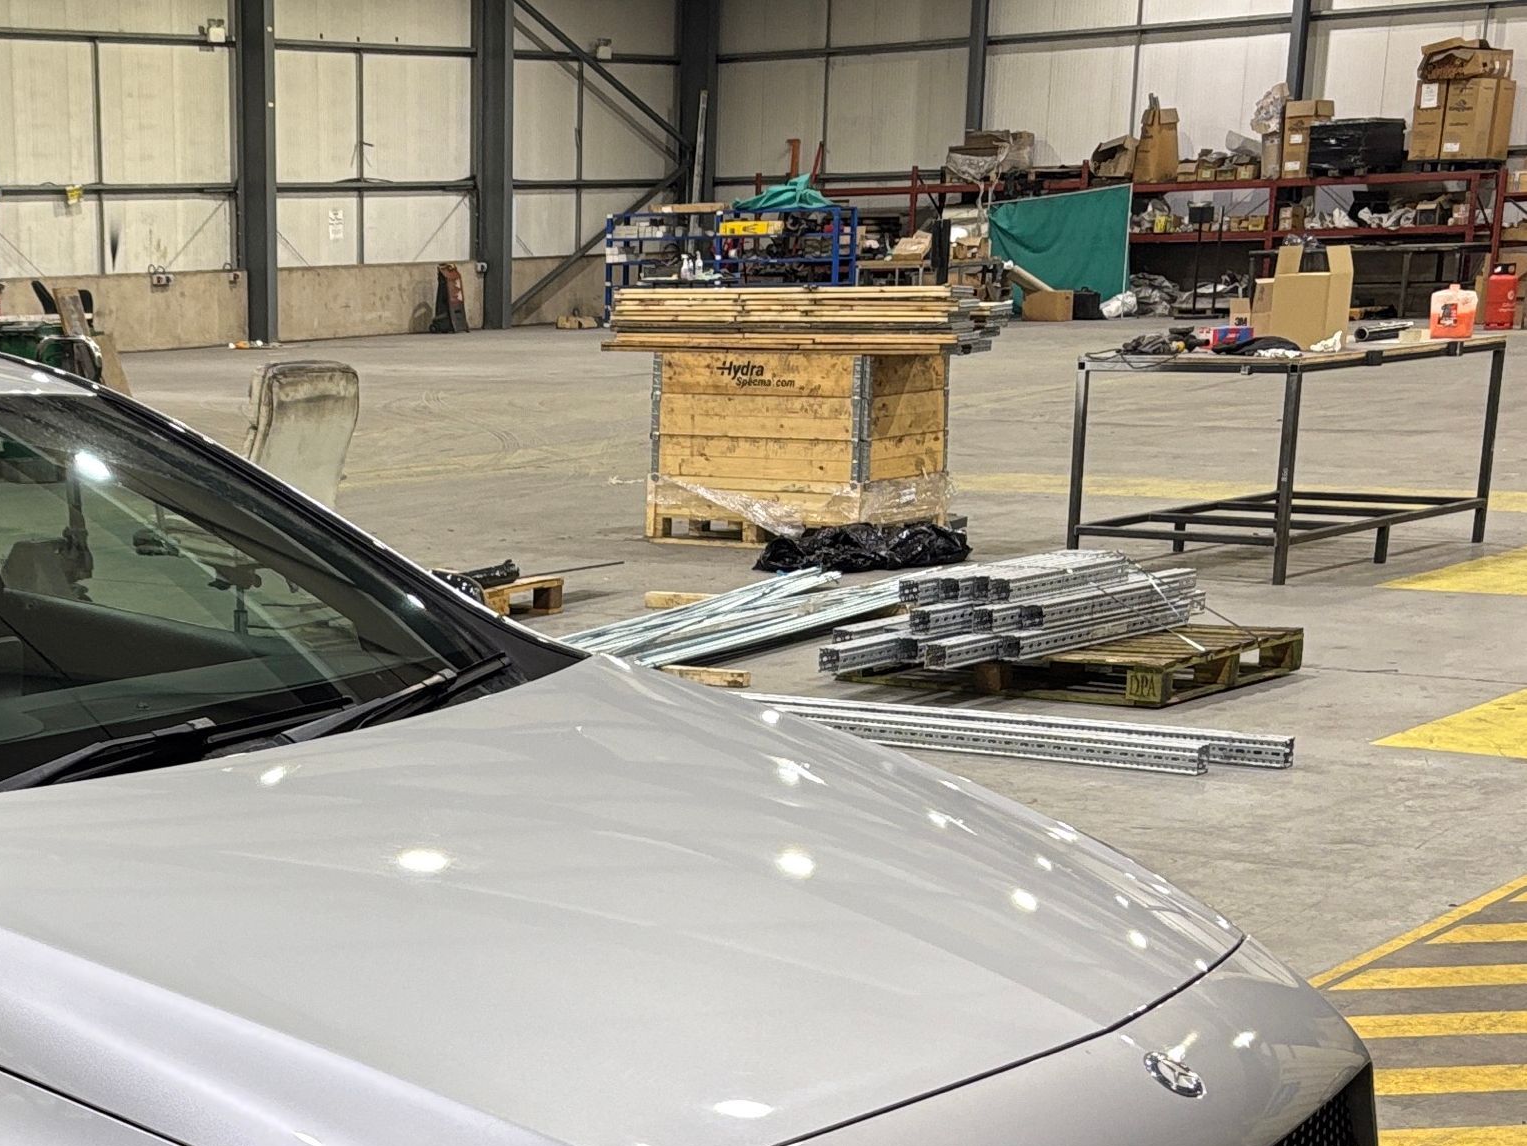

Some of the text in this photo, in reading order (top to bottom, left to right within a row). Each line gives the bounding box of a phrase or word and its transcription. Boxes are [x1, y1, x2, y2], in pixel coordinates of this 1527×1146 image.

[1234, 317, 1248, 327] 3M
[716, 361, 764, 380] Hydra
[1129, 674, 1157, 698] DPA
